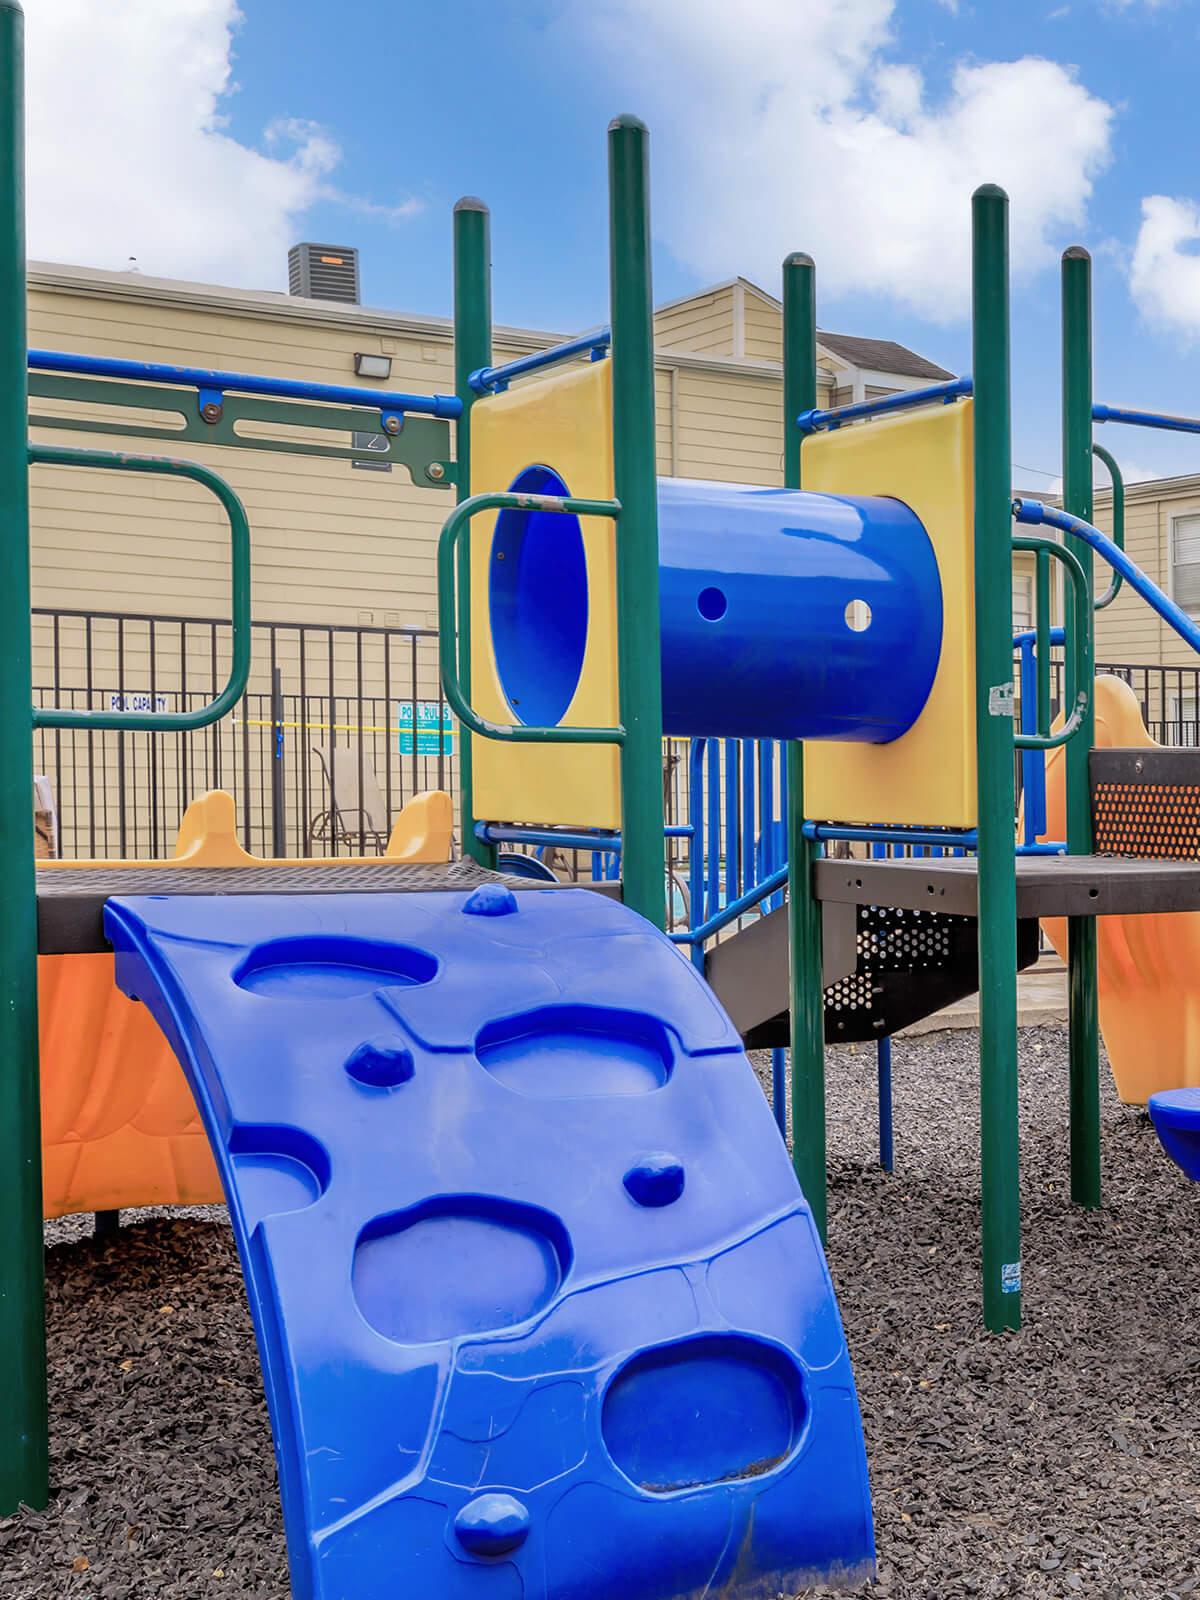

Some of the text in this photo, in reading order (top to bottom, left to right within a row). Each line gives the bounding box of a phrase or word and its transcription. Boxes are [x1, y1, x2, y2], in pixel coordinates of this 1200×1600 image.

[111, 696, 167, 712] POL CAPATY
[401, 706, 449, 720] POL RULS
